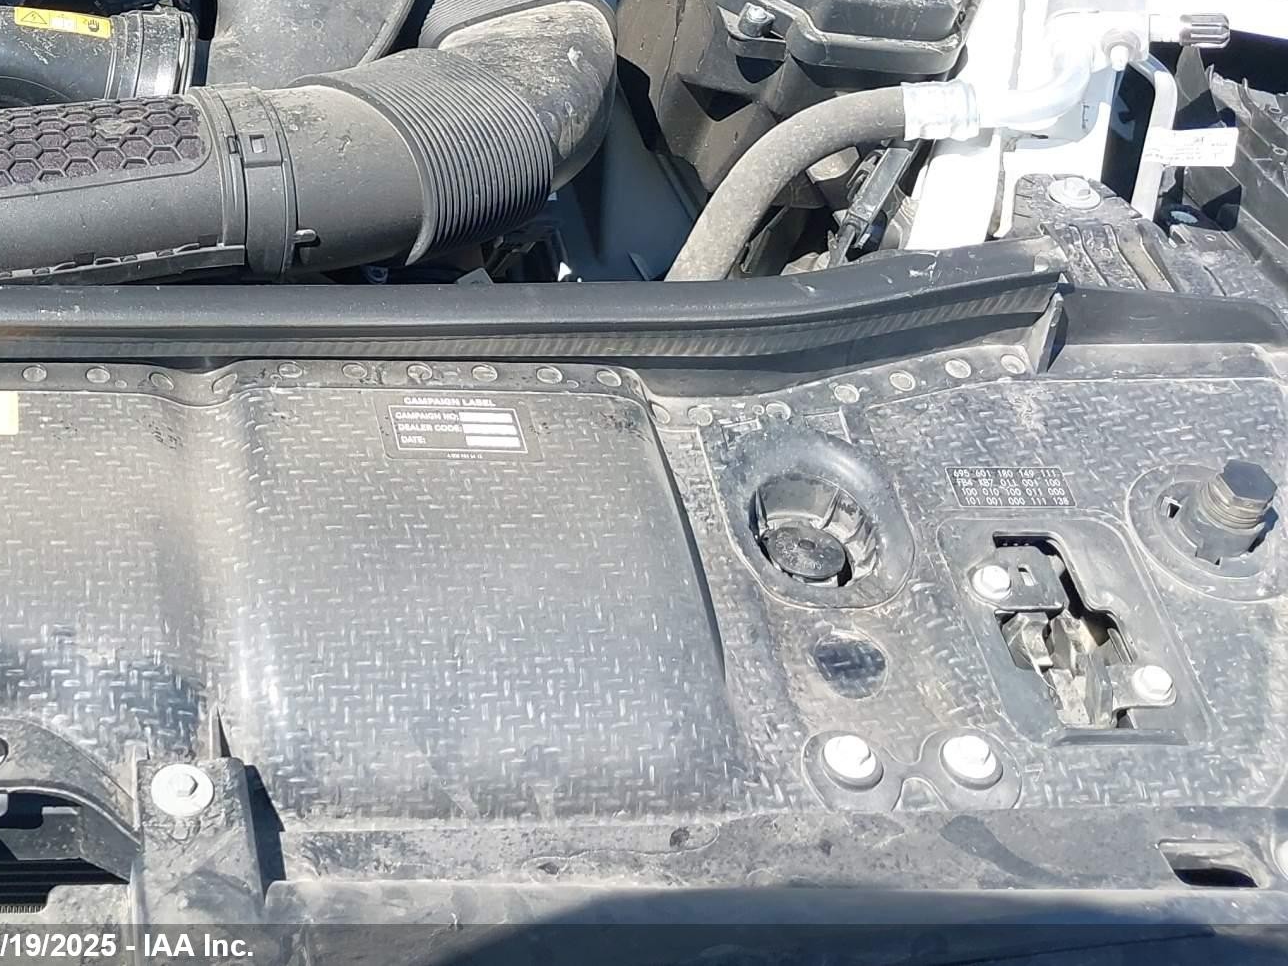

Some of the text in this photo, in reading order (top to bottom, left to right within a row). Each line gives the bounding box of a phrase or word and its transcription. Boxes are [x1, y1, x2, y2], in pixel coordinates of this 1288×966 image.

[403, 396, 497, 408] CAMPAIGN LABEL
[395, 411, 442, 421] CAMPAIGN
[397, 423, 433, 433] DEALER
[400, 435, 427, 445] DATE:
[1040, 469, 1057, 478] 111
[1021, 478, 1039, 487] 001
[1044, 478, 1061, 487] 100
[961, 487, 978, 496] 100
[982, 487, 1000, 496] 010
[1025, 487, 1043, 496] 011
[1047, 487, 1065, 496] 000
[965, 496, 981, 505] 101
[986, 496, 1003, 505] 001
[1008, 496, 1026, 505] 000
[1031, 496, 1047, 505] 111
